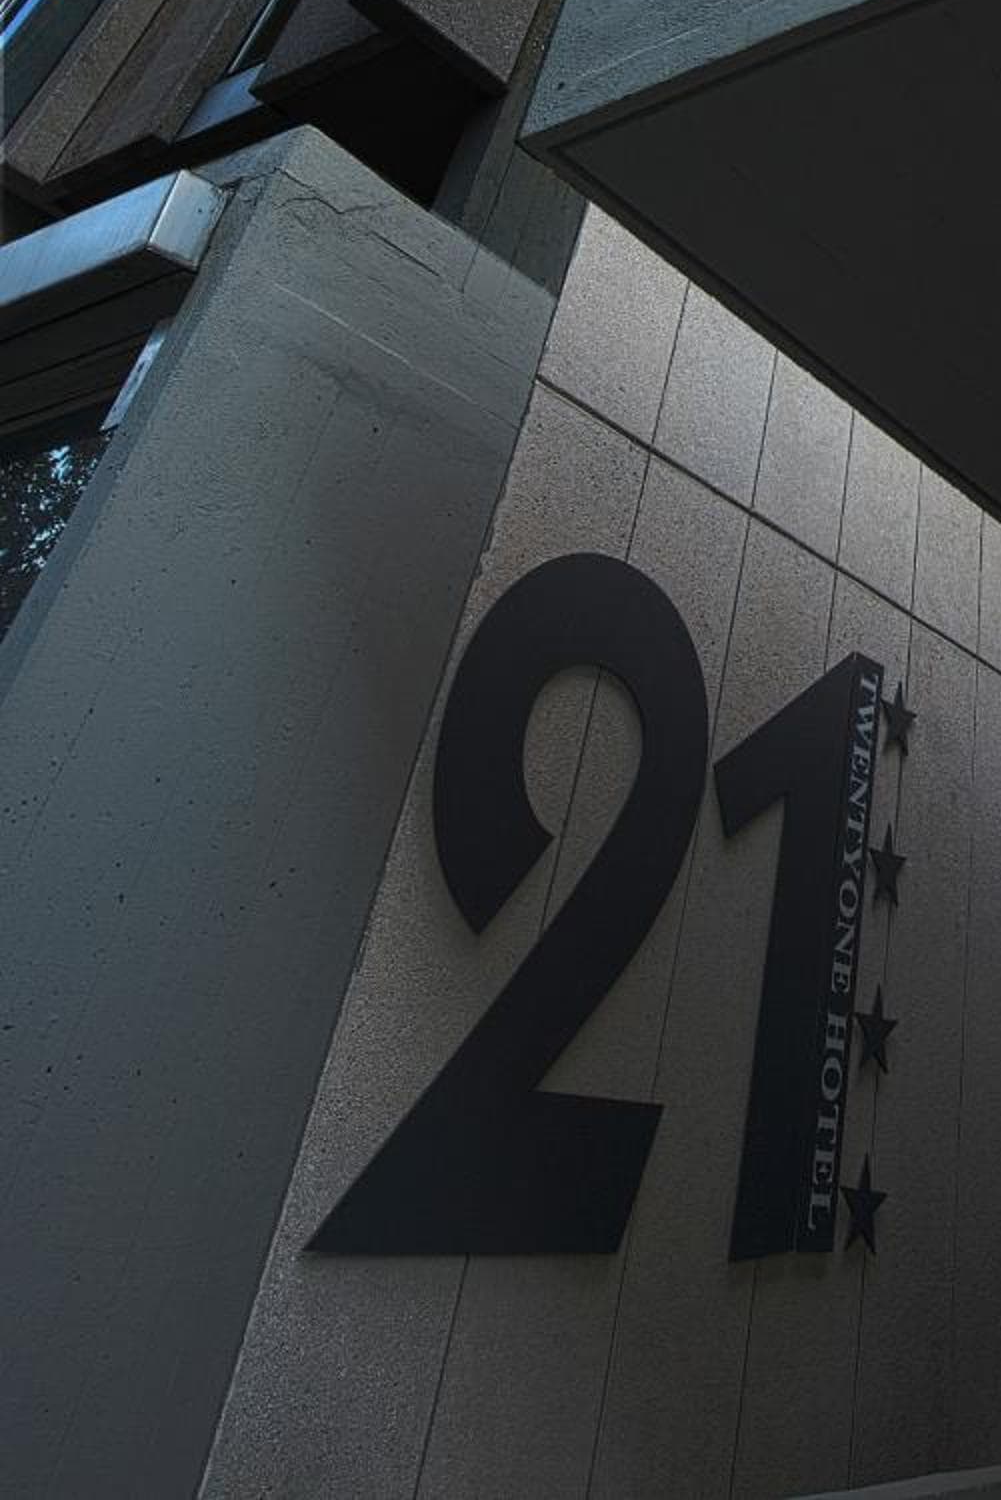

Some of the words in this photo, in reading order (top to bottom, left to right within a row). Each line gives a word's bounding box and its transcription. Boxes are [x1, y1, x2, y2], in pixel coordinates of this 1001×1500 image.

[303, 552, 885, 1262] 21
[831, 672, 879, 995] TWENTYONE
[806, 1011, 849, 1231] HOTEL
